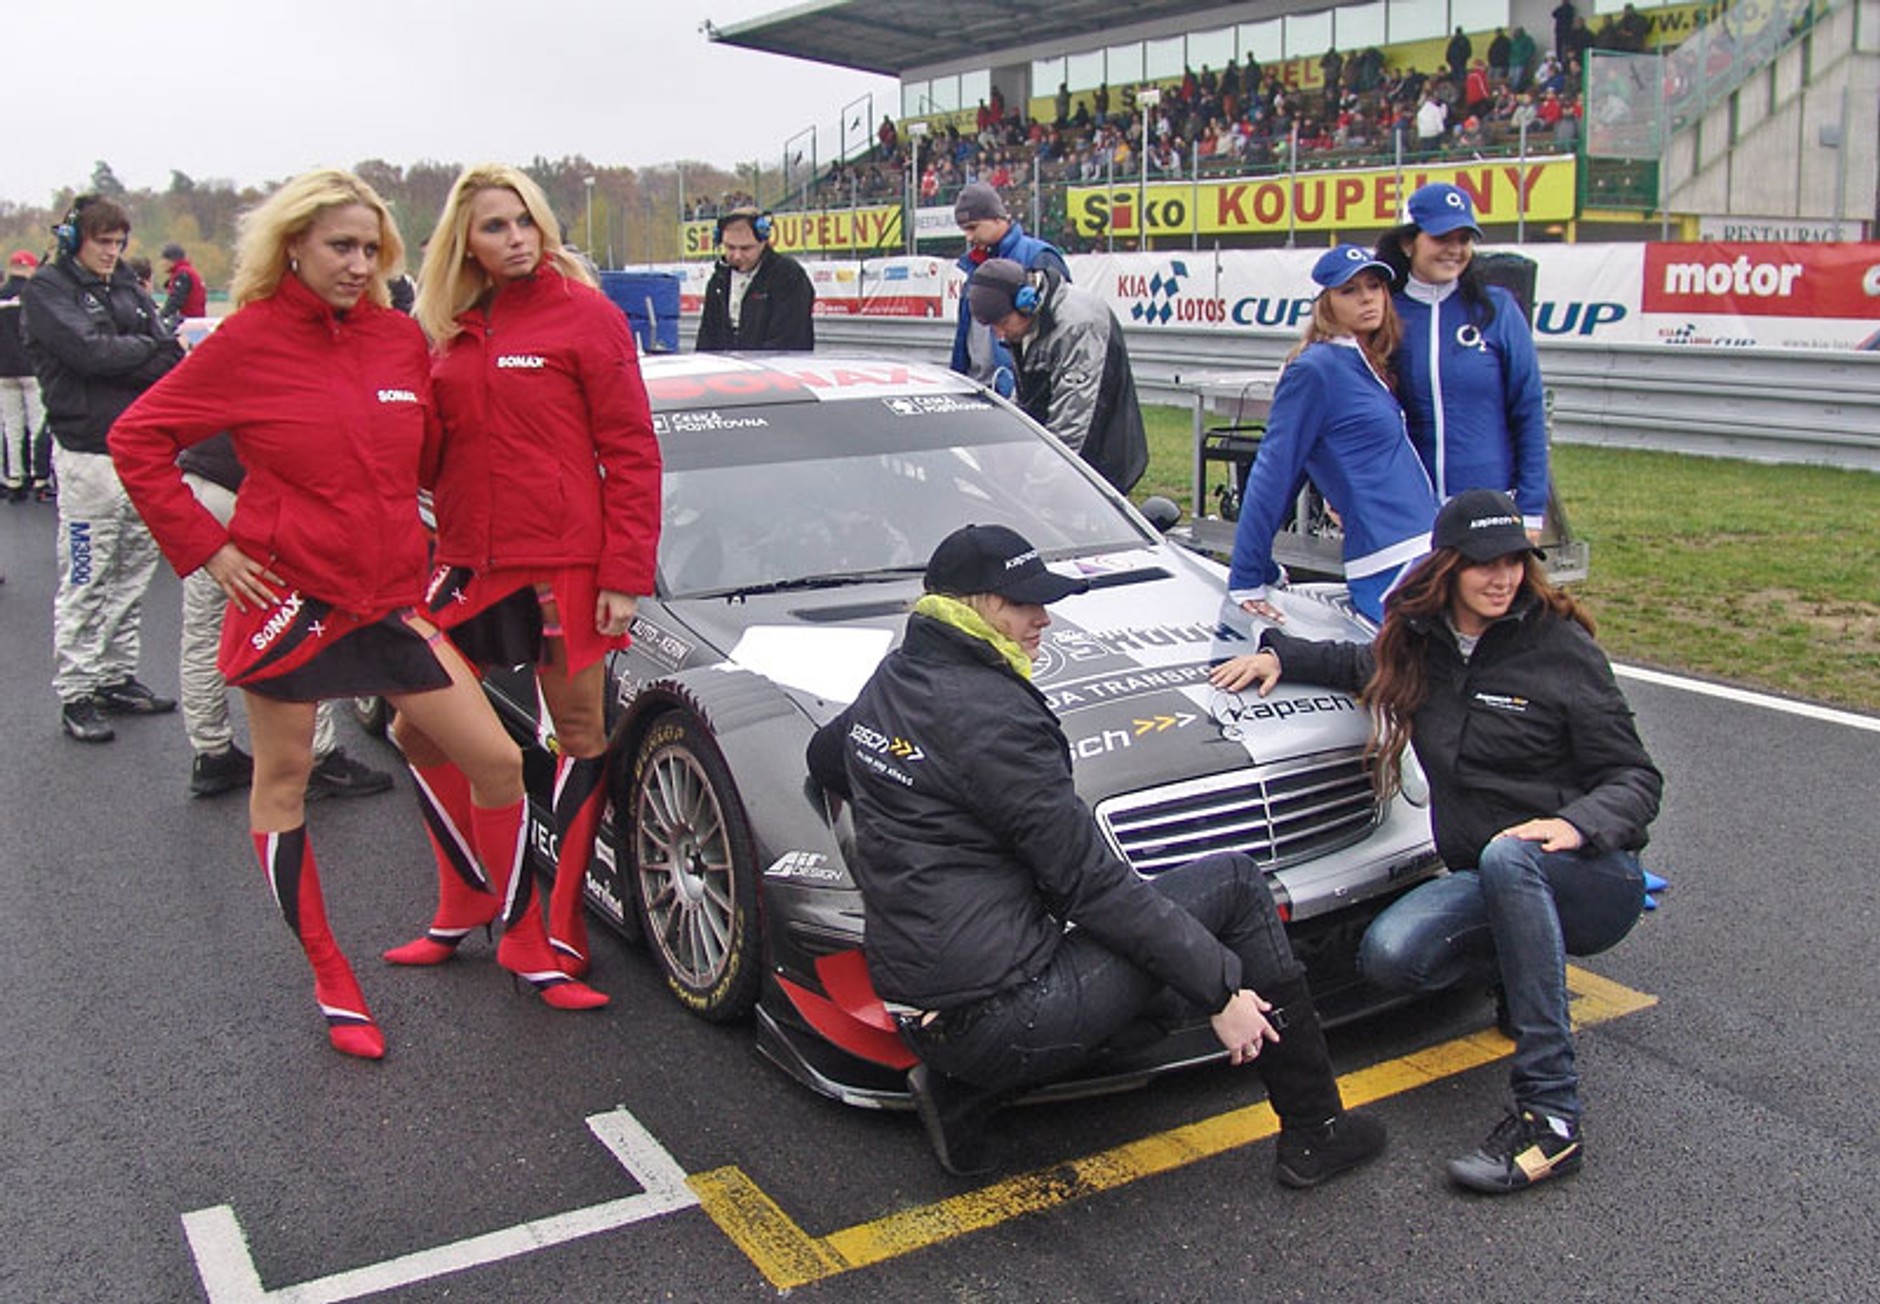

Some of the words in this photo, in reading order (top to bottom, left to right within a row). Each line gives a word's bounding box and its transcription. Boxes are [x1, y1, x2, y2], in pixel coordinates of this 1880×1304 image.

[1083, 192, 1186, 231] Siko
[1218, 164, 1546, 225] KOUPENY
[1117, 274, 1149, 298] KIA
[1664, 254, 1804, 297] motor
[1177, 298, 1226, 322] LOTOS
[1231, 295, 1317, 326] CUP
[1534, 301, 1628, 337] UP
[251, 590, 304, 650] SONAX
